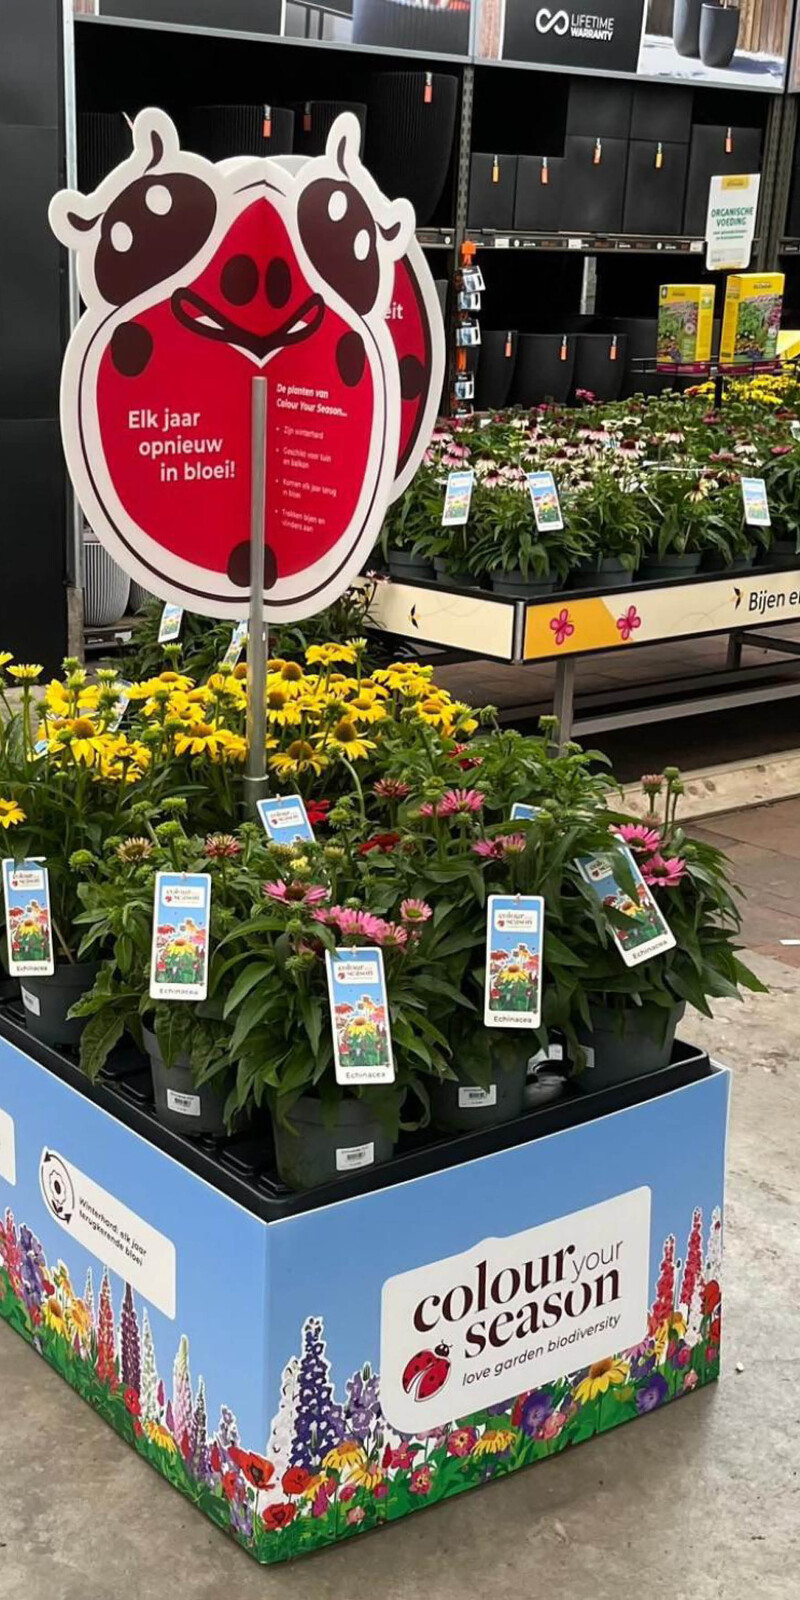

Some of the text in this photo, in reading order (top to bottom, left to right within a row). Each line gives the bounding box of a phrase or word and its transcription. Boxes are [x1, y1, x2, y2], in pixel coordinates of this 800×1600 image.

[571, 13, 615, 31] LIFETIME
[571, 27, 613, 41] WARRANTY
[711, 206, 754, 218] ORGANISCHE
[716, 217, 747, 228] VOEDING
[276, 383, 329, 399] De planten van
[276, 398, 299, 410] Colour
[299, 400, 316, 412] Your
[128, 407, 201, 433] Elk jaar
[138, 434, 223, 460] opnieuw
[160, 459, 236, 482] in bloei!
[748, 589, 800, 615] Bijen e
[631, 939, 668, 960] Echinacea
[159, 987, 199, 996] Echinacea
[493, 1014, 533, 1024] Echinacea
[345, 1070, 386, 1080] Echinacea
[79, 1209, 143, 1267] terugkerende bloei
[120, 1230, 131, 1245] elk
[131, 1239, 148, 1256] jaar
[413, 1240, 624, 1333] colour your
[464, 1268, 623, 1359] season
[462, 1313, 622, 1387] love garden biodiversity
